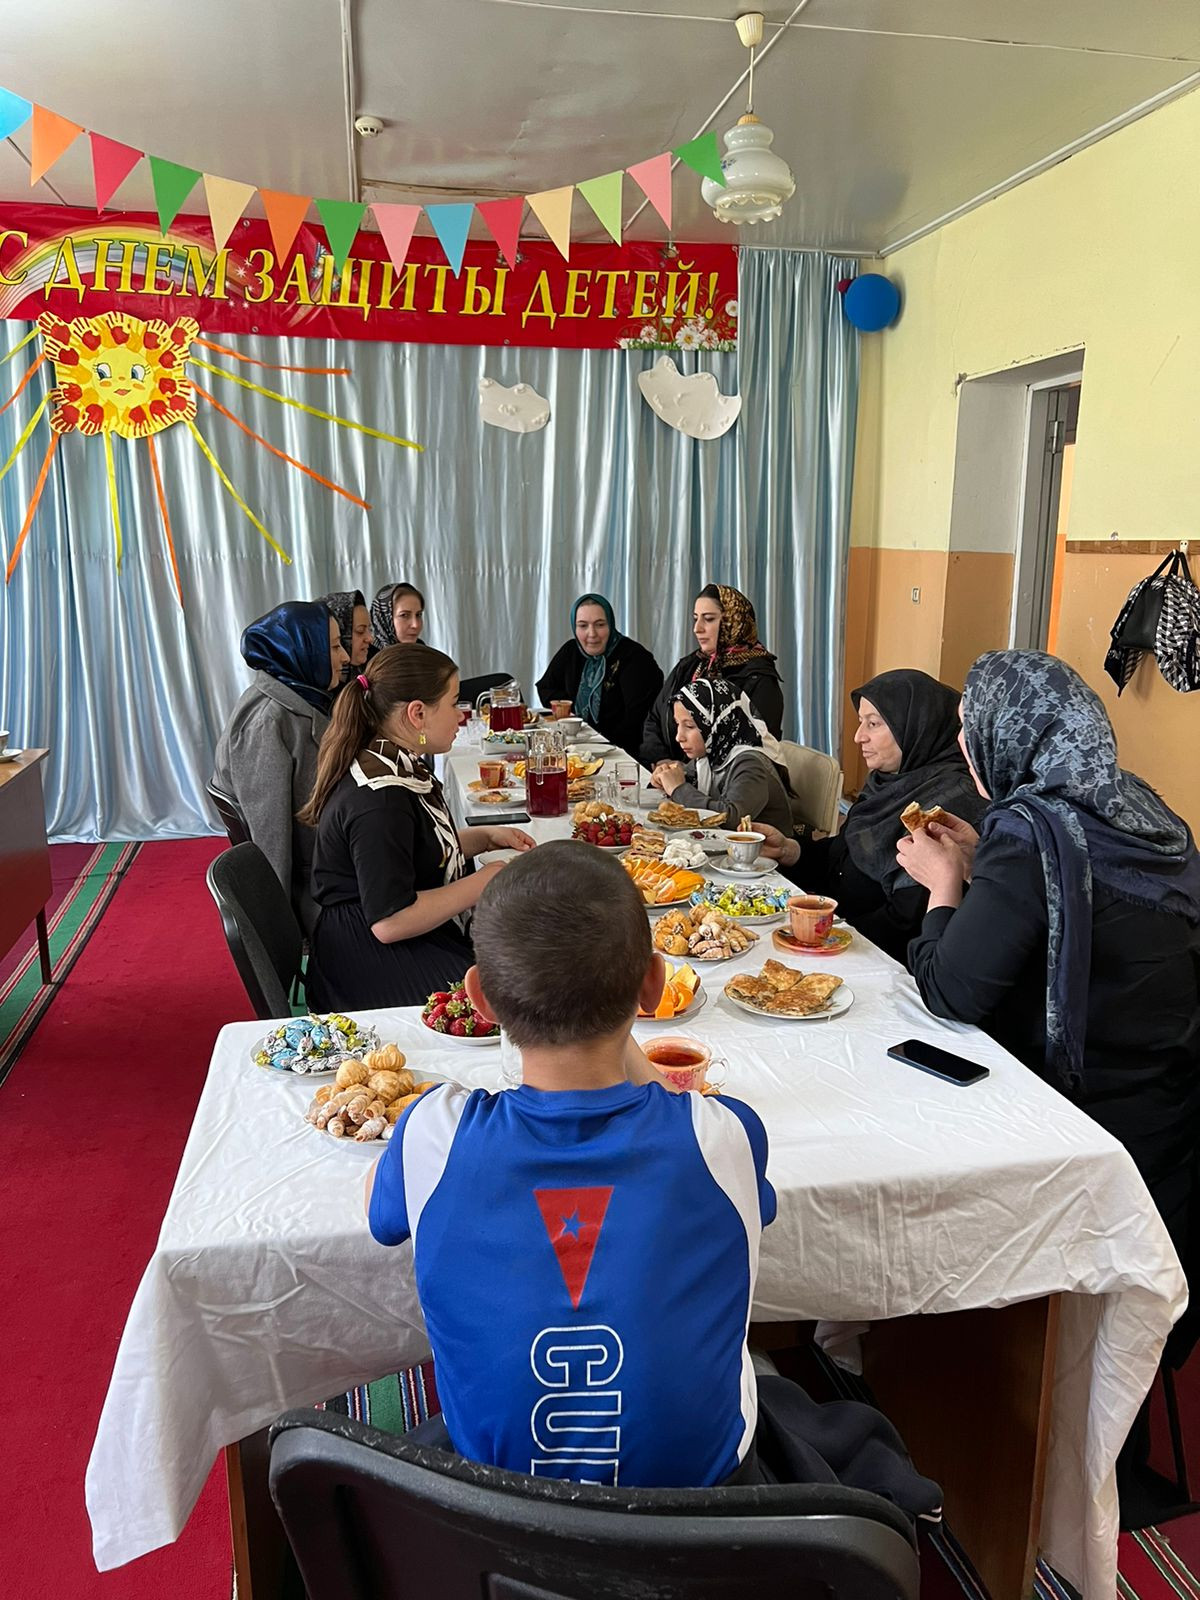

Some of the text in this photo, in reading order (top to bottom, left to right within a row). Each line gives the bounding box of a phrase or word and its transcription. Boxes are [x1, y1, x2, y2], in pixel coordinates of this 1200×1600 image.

[0, 231, 719, 329] С ДНЕМ ЗАЩИТЫ ДЕТЕЙ!
